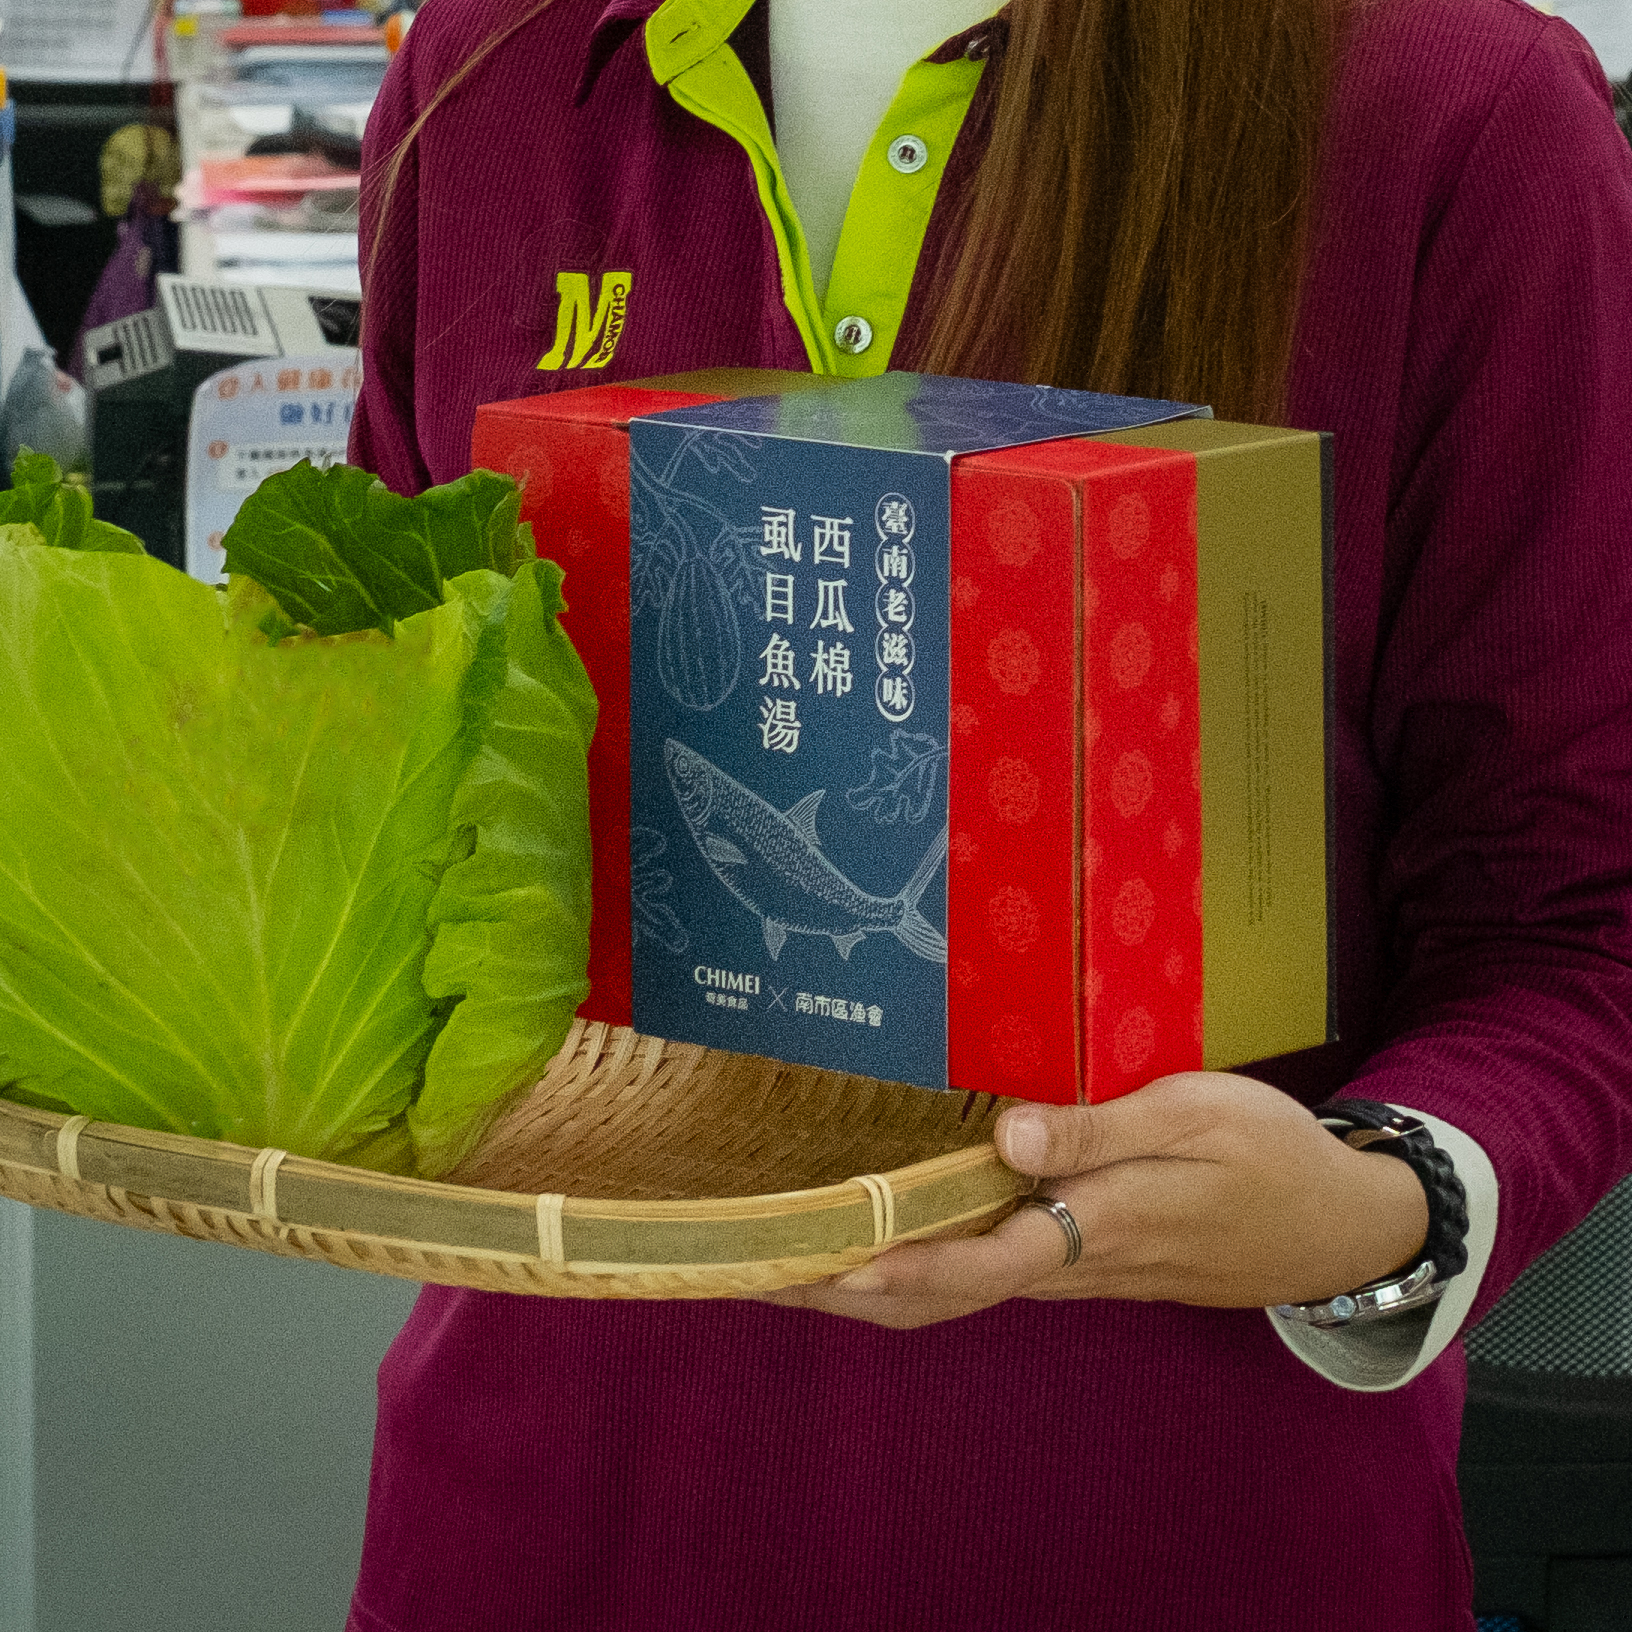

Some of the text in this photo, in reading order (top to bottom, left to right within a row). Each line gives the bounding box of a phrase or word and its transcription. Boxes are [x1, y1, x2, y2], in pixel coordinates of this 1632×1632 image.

[756, 504, 803, 755] 虱目魚湯
[808, 513, 856, 699] 西瓜棉
[879, 499, 911, 711] 臺南老滋味
[693, 965, 761, 996] CHIMEI
[795, 991, 884, 1028] 南市區漁會
